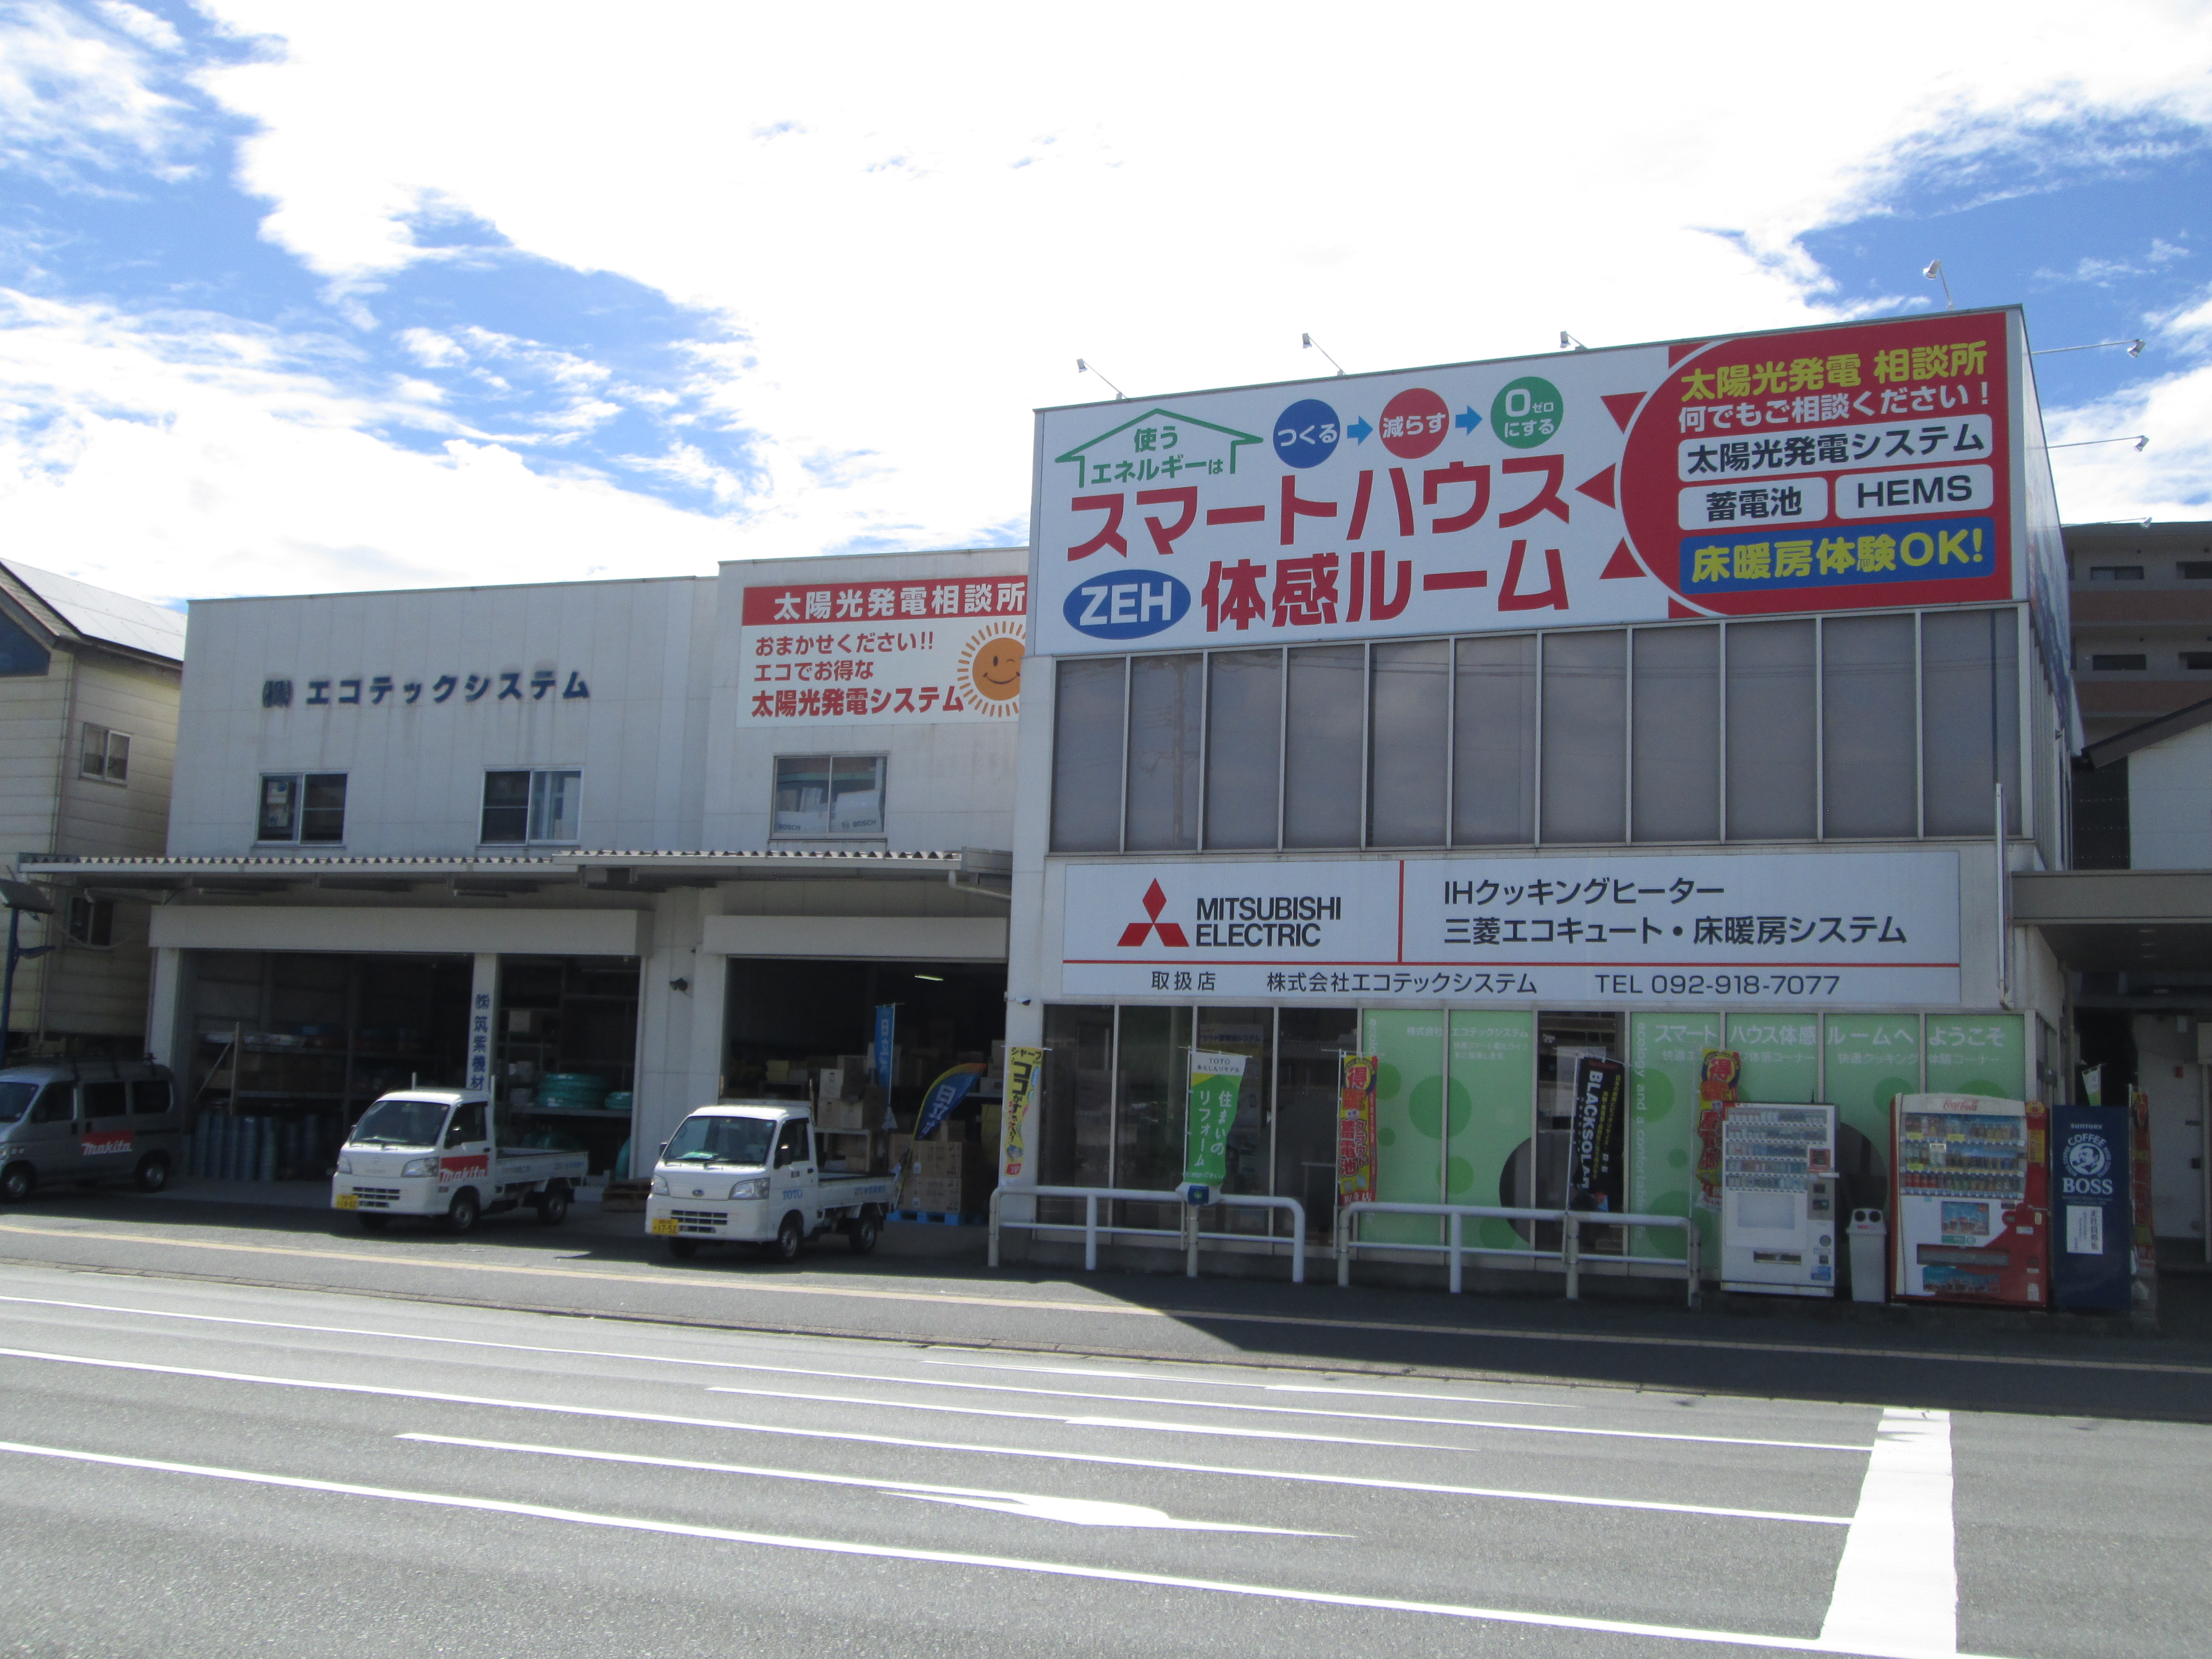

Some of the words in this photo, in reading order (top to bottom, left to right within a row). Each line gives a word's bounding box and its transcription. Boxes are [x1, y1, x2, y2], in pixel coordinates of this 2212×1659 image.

[1681, 353, 1862, 402] 太陽光発電
[1874, 340, 1987, 384] 相談所
[1678, 382, 1989, 433] 何でもご相談ください！
[1277, 424, 1338, 447] つくる
[1382, 412, 1446, 438] 減らす
[1504, 419, 1554, 438] にする
[1134, 427, 1178, 453] 使う
[1687, 424, 1984, 475] 太陽光発電システム
[1091, 455, 1223, 485] エネルギーは
[1706, 487, 1803, 522] 蓄電池
[1857, 475, 1973, 509] HEMS
[1067, 454, 1570, 562] スマートハウス
[1201, 539, 1569, 632] 体感ルーム
[773, 581, 1026, 621] 太陽光発電相談所
[1079, 581, 1172, 626] ZEH
[754, 660, 874, 682] エコでお得な
[751, 685, 964, 718] 太陽光発電システム
[1444, 877, 1724, 906] IHクッキングヒーター
[1196, 896, 1341, 921] MITSUBISHI
[1195, 923, 1321, 948] ELECTRIC
[1444, 916, 1907, 945] 三菱エコキュート・床暖房システム
[1151, 971, 1216, 991] 取扱店
[1267, 972, 1537, 993] 株式会社エコテックシステム
[1595, 975, 1643, 993] TEL
[1651, 975, 1840, 995] 092-918-7077
[1929, 1026, 2005, 1047] ようこそ
[1348, 1066, 1367, 1089] 得
[1636, 1084, 1647, 1111] and
[1194, 1091, 1211, 1167] リフォーム
[1210, 1090, 1232, 1155] 住まいの
[2068, 1133, 2106, 1147] COFFEE
[782, 1189, 803, 1200] TOTO
[2062, 1178, 2113, 1195] BOSS
